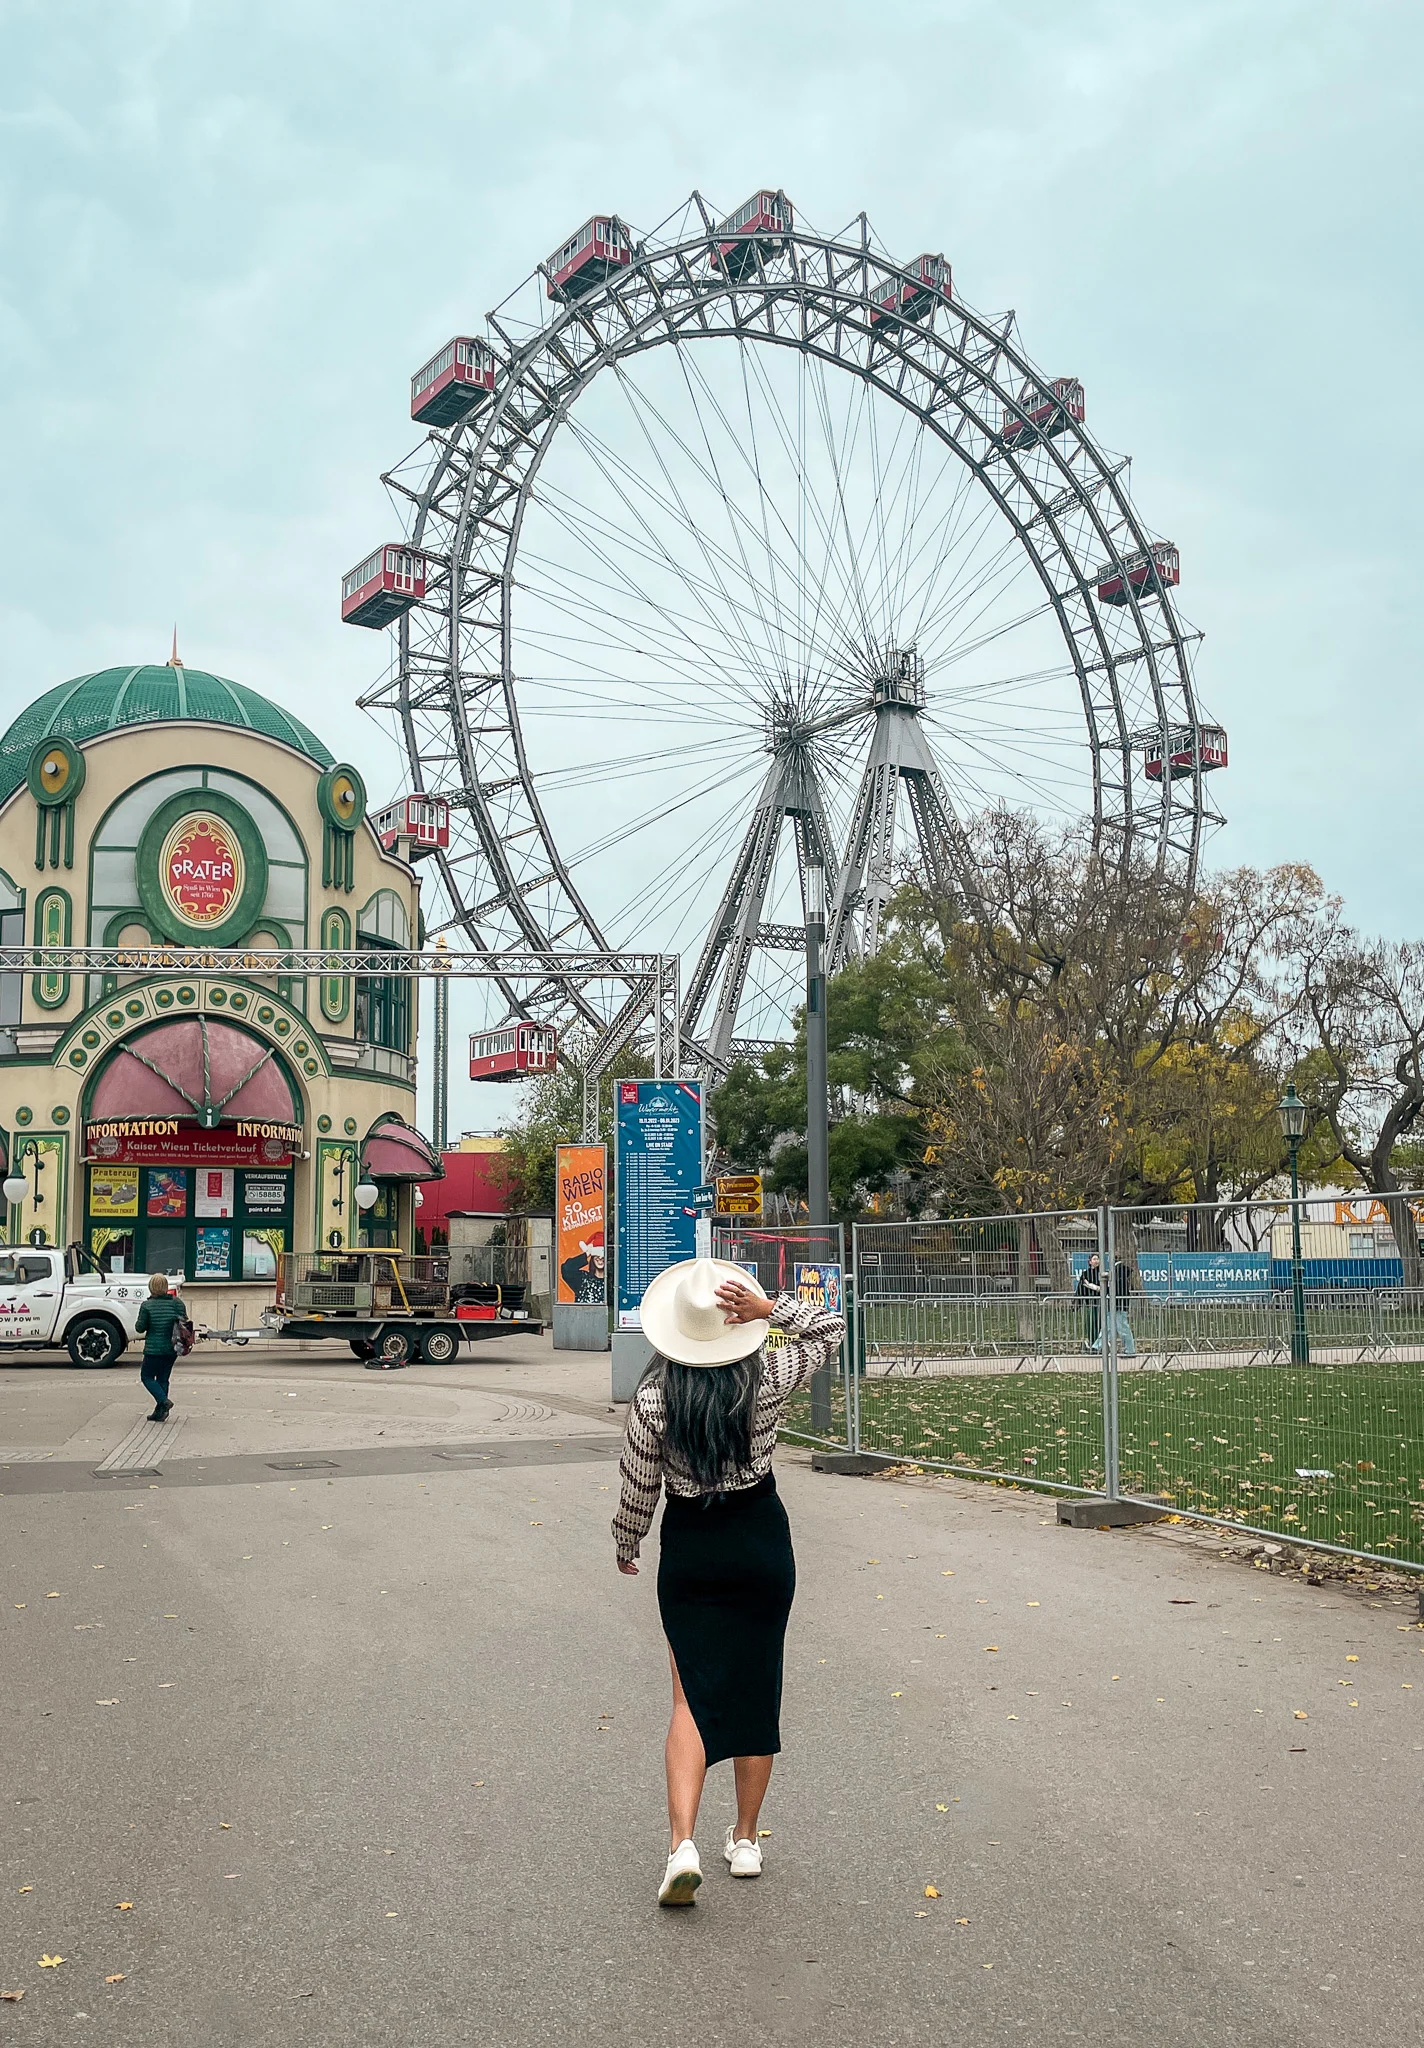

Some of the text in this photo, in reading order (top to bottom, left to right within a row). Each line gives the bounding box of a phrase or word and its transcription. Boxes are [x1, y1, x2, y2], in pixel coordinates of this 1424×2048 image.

[172, 859, 233, 880] PRATER
[87, 1121, 179, 1140] INFORMATION
[127, 1141, 158, 1151] Kaiser
[160, 1142, 190, 1151] Wiesn
[193, 1142, 257, 1153] Ticketverkauf
[93, 1168, 137, 1178] Praterzug
[562, 1168, 603, 1190] RADIO
[562, 1179, 603, 1201] WIEN
[562, 1205, 602, 1227] KLINGT
[565, 1201, 582, 1216] SO
[1174, 1269, 1269, 1282] WINTERMARKT
[797, 1286, 825, 1307] CIRCUS
